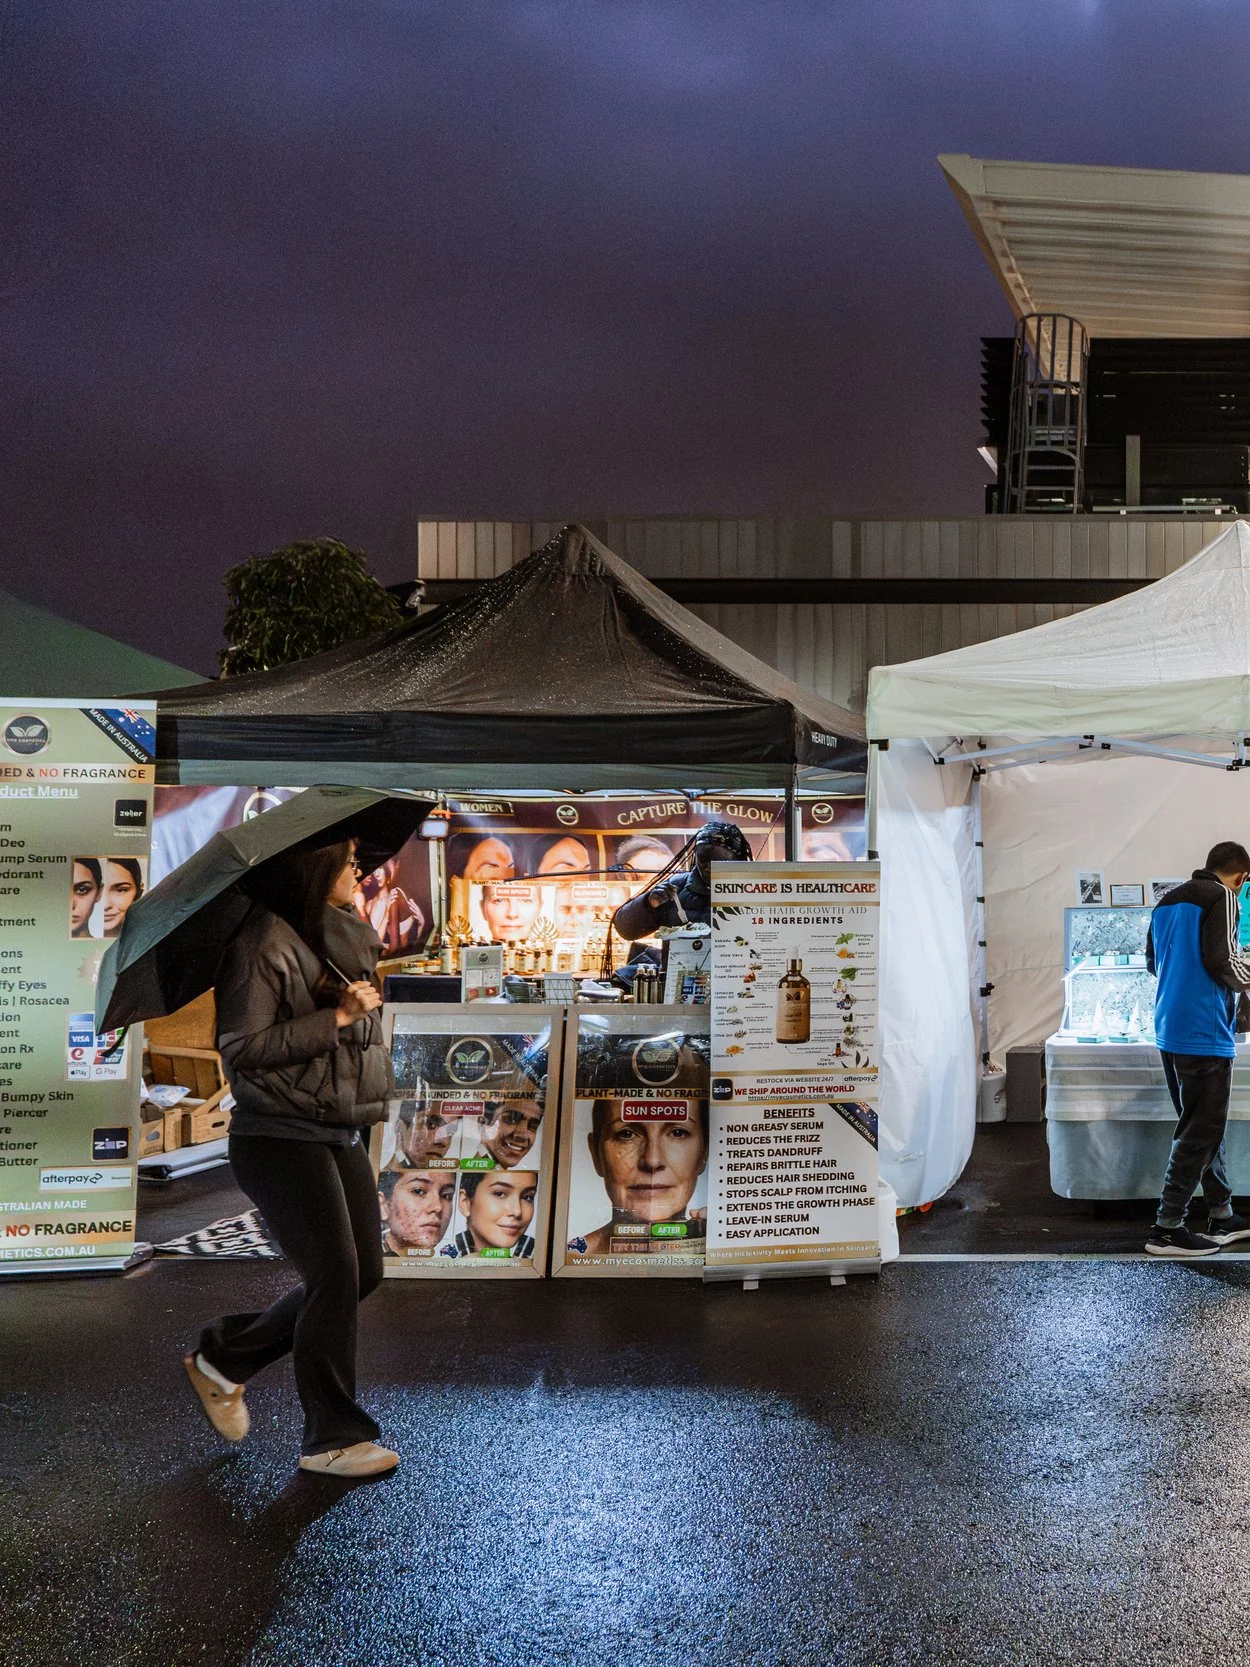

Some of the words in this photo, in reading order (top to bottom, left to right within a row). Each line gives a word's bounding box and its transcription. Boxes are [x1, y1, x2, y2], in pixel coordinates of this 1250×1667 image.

[89, 708, 107, 726] MADE
[106, 724, 117, 734] IN
[114, 731, 148, 763] AUSTRALIA
[811, 731, 826, 746] HEAVY
[826, 735, 838, 748] DUTY
[0, 768, 22, 778] ED
[26, 768, 35, 778] &
[39, 768, 59, 778] NO
[63, 768, 146, 779] FRAGRANCE
[37, 785, 79, 797] Menu
[460, 802, 503, 813] WOMEN
[617, 802, 687, 825] CAPTURE
[690, 801, 722, 815] THE
[725, 803, 774, 824] GLOW
[0, 838, 25, 848] Deo
[28, 854, 67, 864] Serum
[0, 869, 44, 879] dorant
[714, 883, 777, 894] SKINCARE
[781, 883, 793, 893] IS
[796, 883, 876, 894] HEALTHCARE
[769, 907, 795, 915] HAIR
[798, 906, 845, 915] GROWTH
[848, 906, 867, 914] AID
[751, 917, 764, 925] 18
[768, 916, 843, 925] INGREDIENTS
[18, 980, 47, 992] Eyes
[20, 996, 70, 1006] Rosacea
[71, 1035, 90, 1043] VISA
[20, 1044, 34, 1053] Rx
[463, 1090, 470, 1099] &
[576, 1089, 643, 1098] PLANT-MADE
[646, 1089, 654, 1098] &
[656, 1089, 672, 1098] NO
[734, 1088, 747, 1096] WE
[749, 1087, 768, 1095] SHIP
[770, 1086, 806, 1095] AROUND
[826, 1085, 855, 1093] WORLD
[1, 1092, 45, 1104] Bumpy
[48, 1091, 74, 1101] Skin
[3, 1108, 48, 1118] Piercer
[625, 1106, 648, 1115] SUN
[650, 1106, 686, 1115] SPOTS
[763, 1108, 815, 1119] BENEFITS
[726, 1124, 749, 1132] NON
[751, 1122, 788, 1132] GREASY
[790, 1121, 824, 1131] SERUM
[836, 1103, 850, 1117] MADE
[853, 1120, 876, 1142] AUSTRALIA
[726, 1136, 771, 1145] REDUCES
[773, 1135, 792, 1144] THE
[794, 1134, 821, 1143] FRIZZ
[727, 1149, 765, 1159] TREATS
[767, 1147, 823, 1157] DANDRUFF
[0, 1156, 38, 1167] Butter
[428, 1159, 456, 1168] BEFORE
[466, 1160, 488, 1168] AFTER
[727, 1162, 769, 1171] REPAIRS
[770, 1160, 810, 1170] BRITTLE
[812, 1159, 837, 1168] HAIR
[42, 1174, 90, 1185] afterpay
[726, 1175, 774, 1185] REDUCES
[776, 1174, 800, 1183] HAIR
[802, 1172, 855, 1182] SHEDDING
[726, 1188, 759, 1198] STOPS
[760, 1187, 793, 1197] SCALP
[795, 1186, 824, 1195] FROM
[826, 1184, 868, 1194] ITCHING
[54, 1199, 87, 1209] MADE
[726, 1202, 773, 1212] EXTENDS
[774, 1201, 794, 1210] THE
[796, 1199, 840, 1209] GROWTH
[842, 1197, 875, 1207] PHASE
[726, 1215, 772, 1226] LEAVE-IN
[774, 1213, 810, 1223] SERUM
[5, 1223, 30, 1237] NO
[34, 1220, 132, 1236] FRAGRANCE
[617, 1226, 646, 1234] BEFORE
[657, 1226, 680, 1234] AFTER
[726, 1229, 751, 1239] EASY
[753, 1226, 820, 1238] APPLICATION
[407, 1248, 432, 1256] BEFORE
[485, 1249, 505, 1257] AFTER
[735, 1250, 772, 1258] Inclusivity
